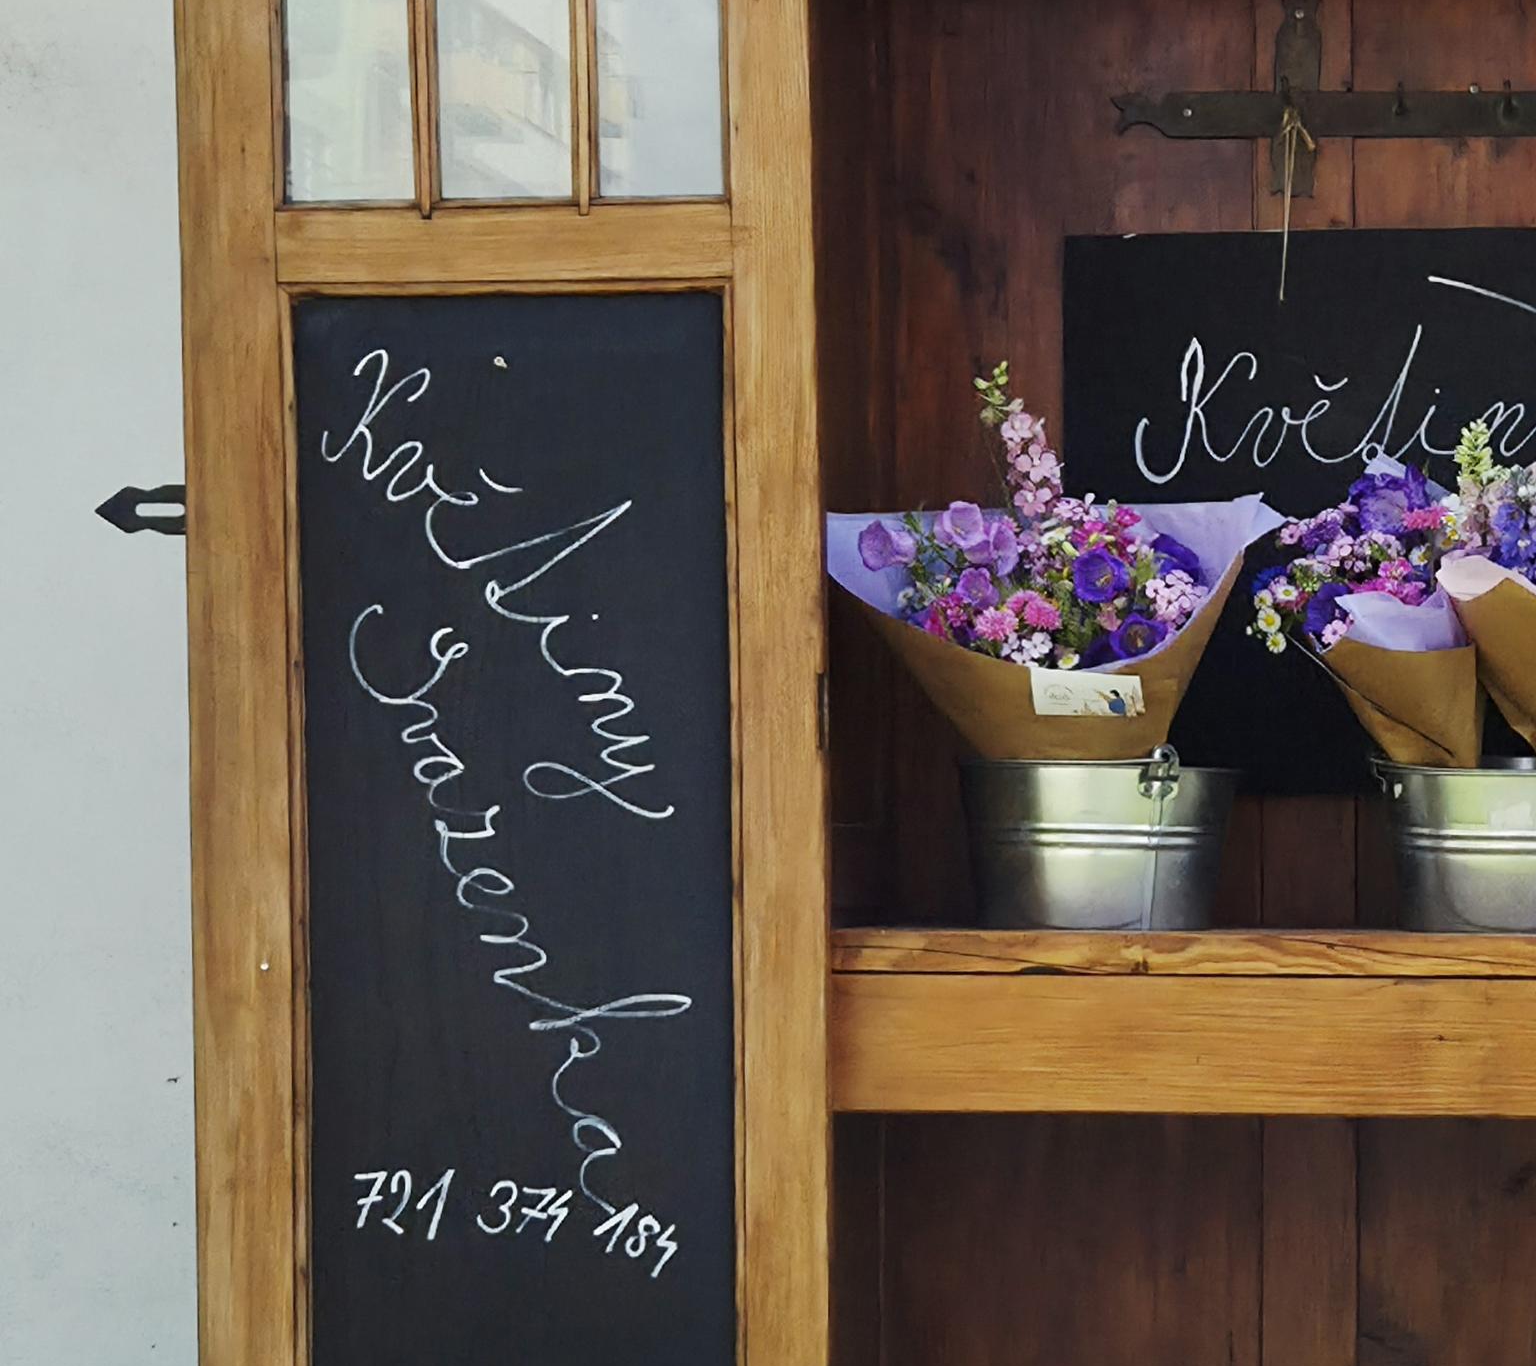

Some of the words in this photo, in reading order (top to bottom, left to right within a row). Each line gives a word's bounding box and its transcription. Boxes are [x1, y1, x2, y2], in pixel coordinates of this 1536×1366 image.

[354, 1168, 456, 1241] 721
[476, 1180, 574, 1243] 374
[592, 1202, 679, 1278] 184
